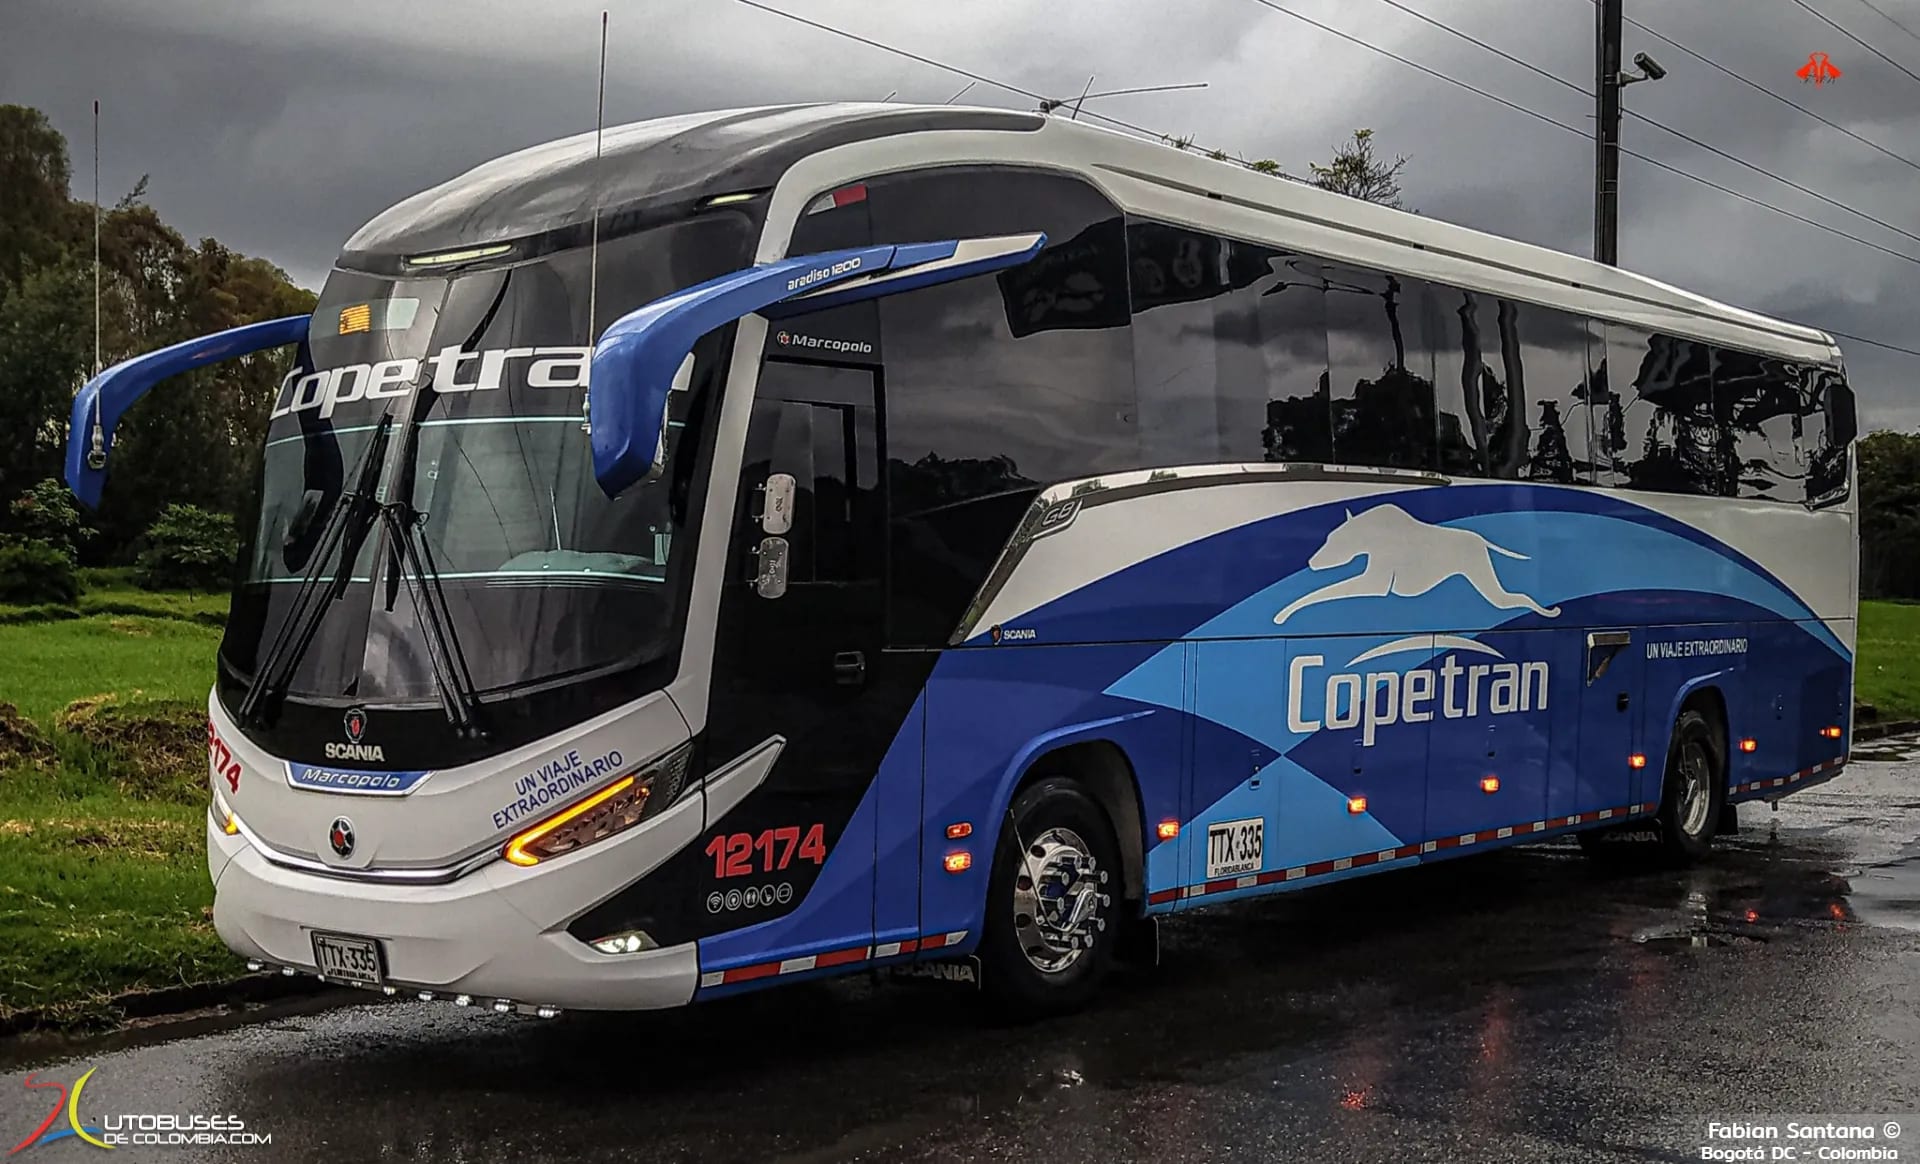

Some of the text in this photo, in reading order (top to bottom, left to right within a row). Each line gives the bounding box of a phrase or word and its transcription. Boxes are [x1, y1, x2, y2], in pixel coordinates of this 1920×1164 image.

[787, 257, 861, 290] aradiso 1200
[792, 334, 872, 353] Marcopolo
[1043, 501, 1076, 526] G8
[1003, 629, 1037, 640] SCANIA
[1646, 638, 1748, 659] UN VIAJE EXTRAORDINARIO
[1287, 655, 1549, 747] Copetran
[325, 742, 385, 762] SCANIA
[302, 768, 401, 788] Marcopolo
[515, 750, 582, 796] UN VIAJE
[493, 750, 624, 830] EXTRAORDINARIO
[705, 824, 826, 878] 12174
